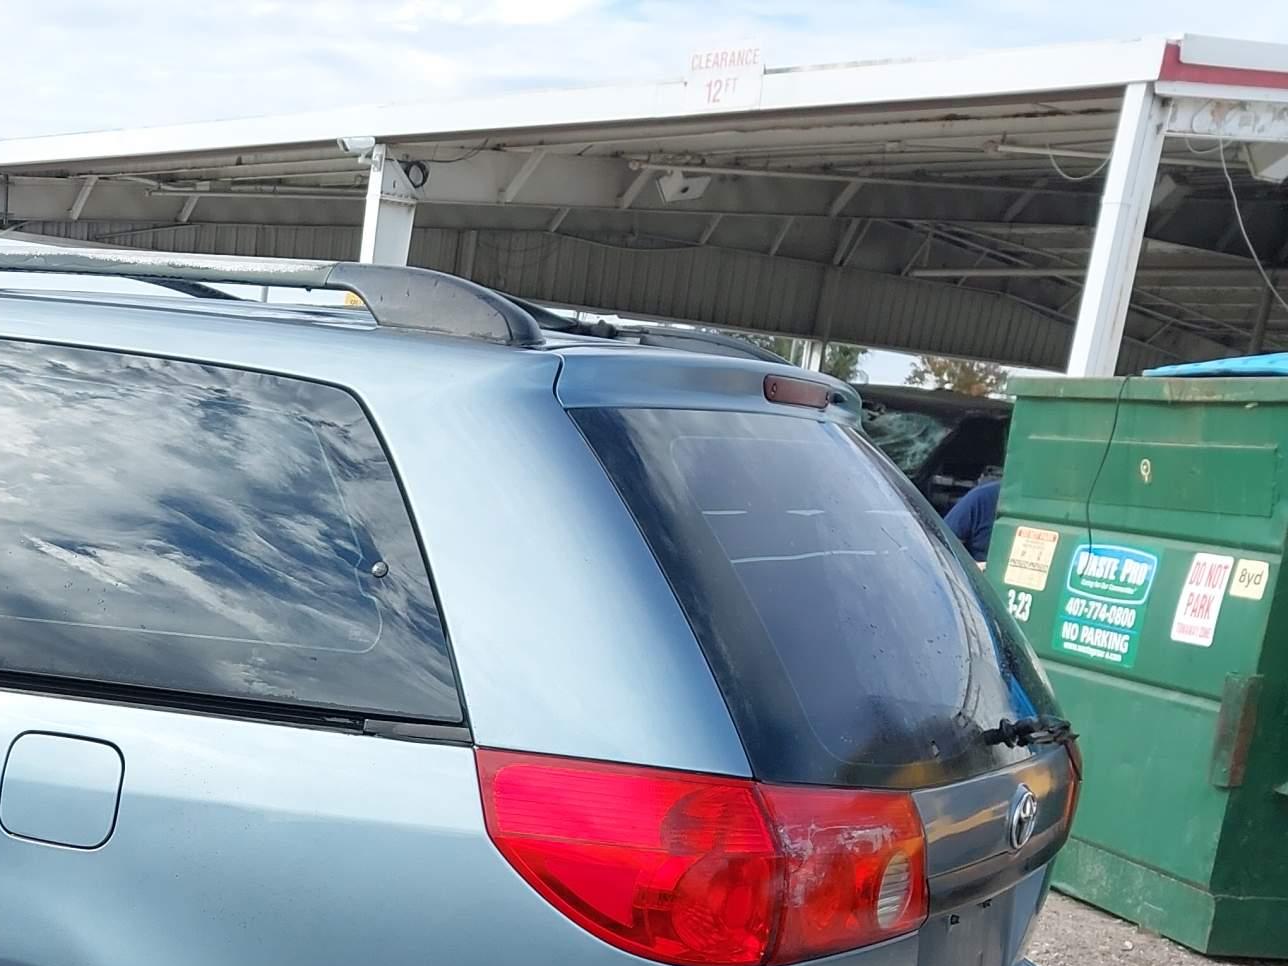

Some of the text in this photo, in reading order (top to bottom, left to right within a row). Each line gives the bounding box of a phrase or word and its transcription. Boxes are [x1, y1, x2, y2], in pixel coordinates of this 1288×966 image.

[691, 48, 760, 70] CLEARANCE
[705, 78, 739, 104] 12 FT
[1076, 552, 1120, 580] WASTE
[1120, 558, 1149, 586] PRO
[1189, 561, 1230, 590] DO NOT
[1238, 568, 1264, 588] 8yd
[1065, 597, 1137, 629] 407-774-0800
[1183, 592, 1215, 620] PARK
[1062, 621, 1079, 641] NO
[1079, 625, 1130, 654] PARKING
